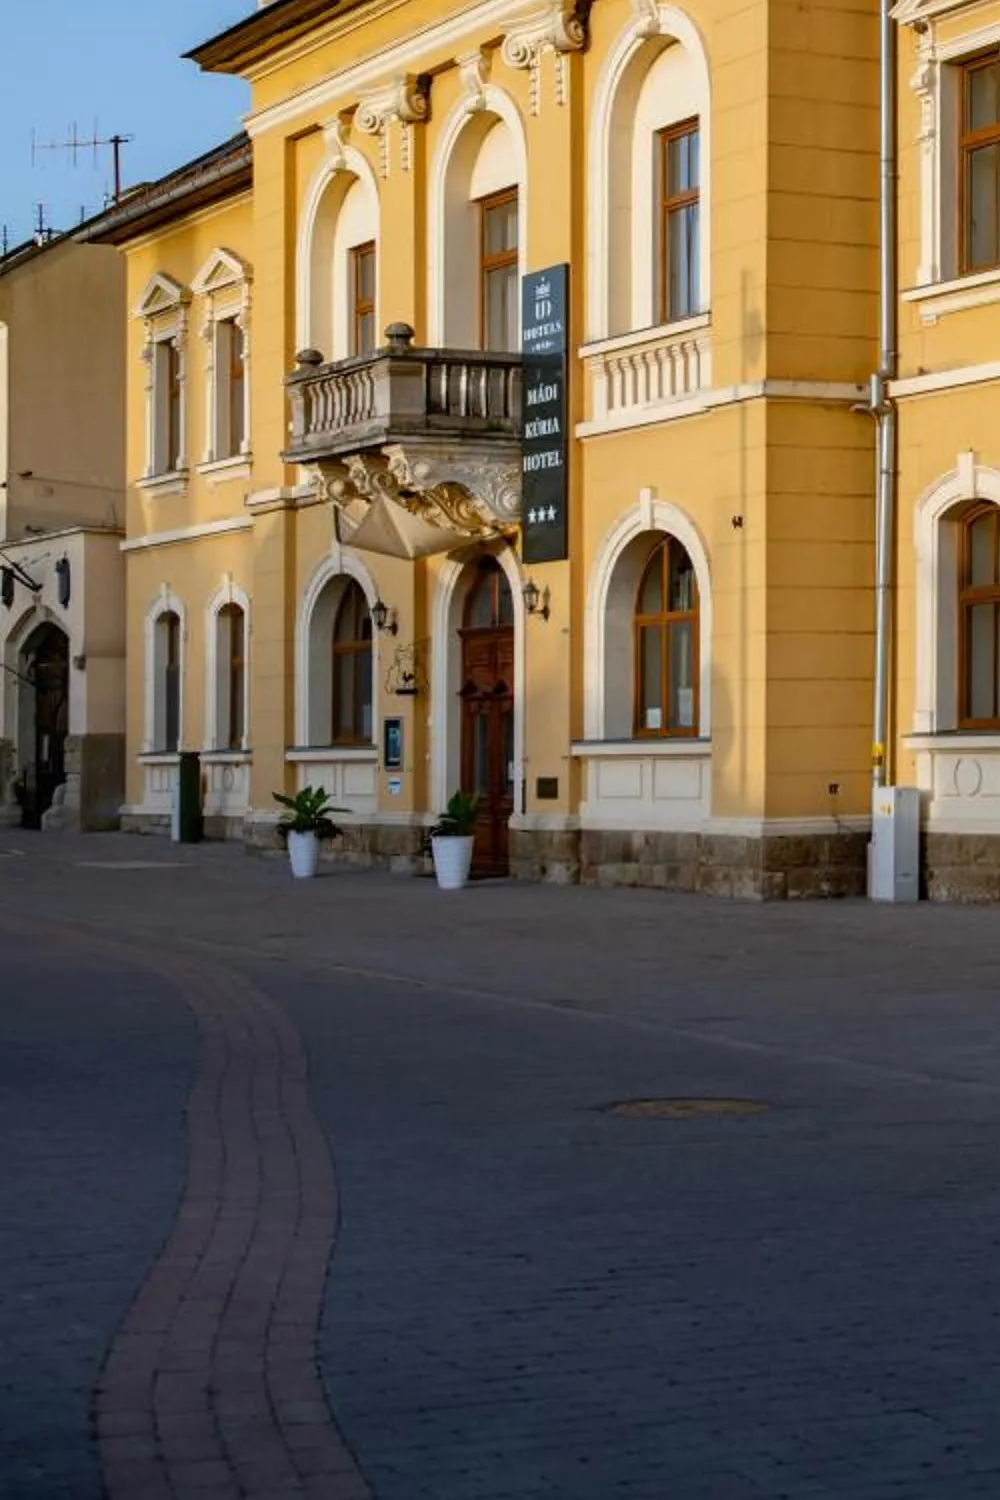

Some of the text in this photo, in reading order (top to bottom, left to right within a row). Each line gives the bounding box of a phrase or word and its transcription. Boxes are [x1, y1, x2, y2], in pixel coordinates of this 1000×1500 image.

[527, 383, 558, 406] MÁDI
[525, 417, 560, 439] KÚRIA
[523, 451, 561, 473] HOTEL
